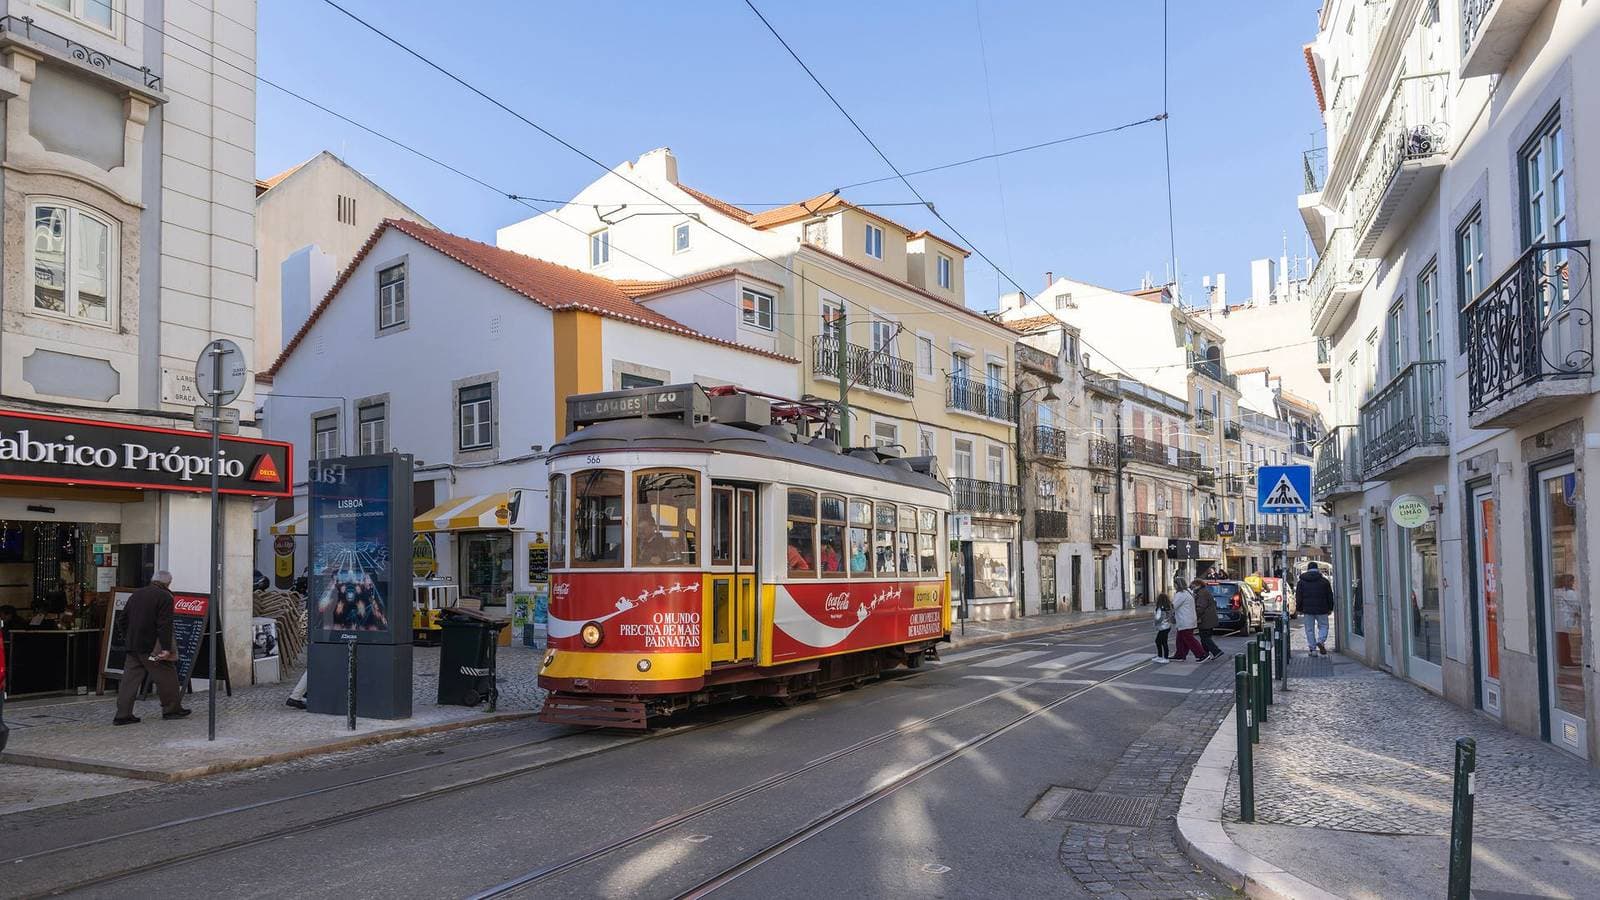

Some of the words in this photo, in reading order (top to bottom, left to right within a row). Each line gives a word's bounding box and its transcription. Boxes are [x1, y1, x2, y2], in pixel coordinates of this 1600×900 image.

[0, 429, 118, 468] abrico
[121, 443, 245, 481] Próprio
[586, 456, 601, 465] 566
[337, 498, 363, 509] LISBOA
[174, 599, 204, 612] Coca-Cola
[825, 592, 850, 611] Coca-Cola
[653, 612, 663, 624] O
[664, 612, 700, 624] MUNDO
[620, 624, 661, 636] PRECISA
[663, 624, 677, 636] DE
[678, 624, 700, 636] MAIS
[645, 635, 665, 648] PAIS
[667, 635, 700, 648] NATAIS
